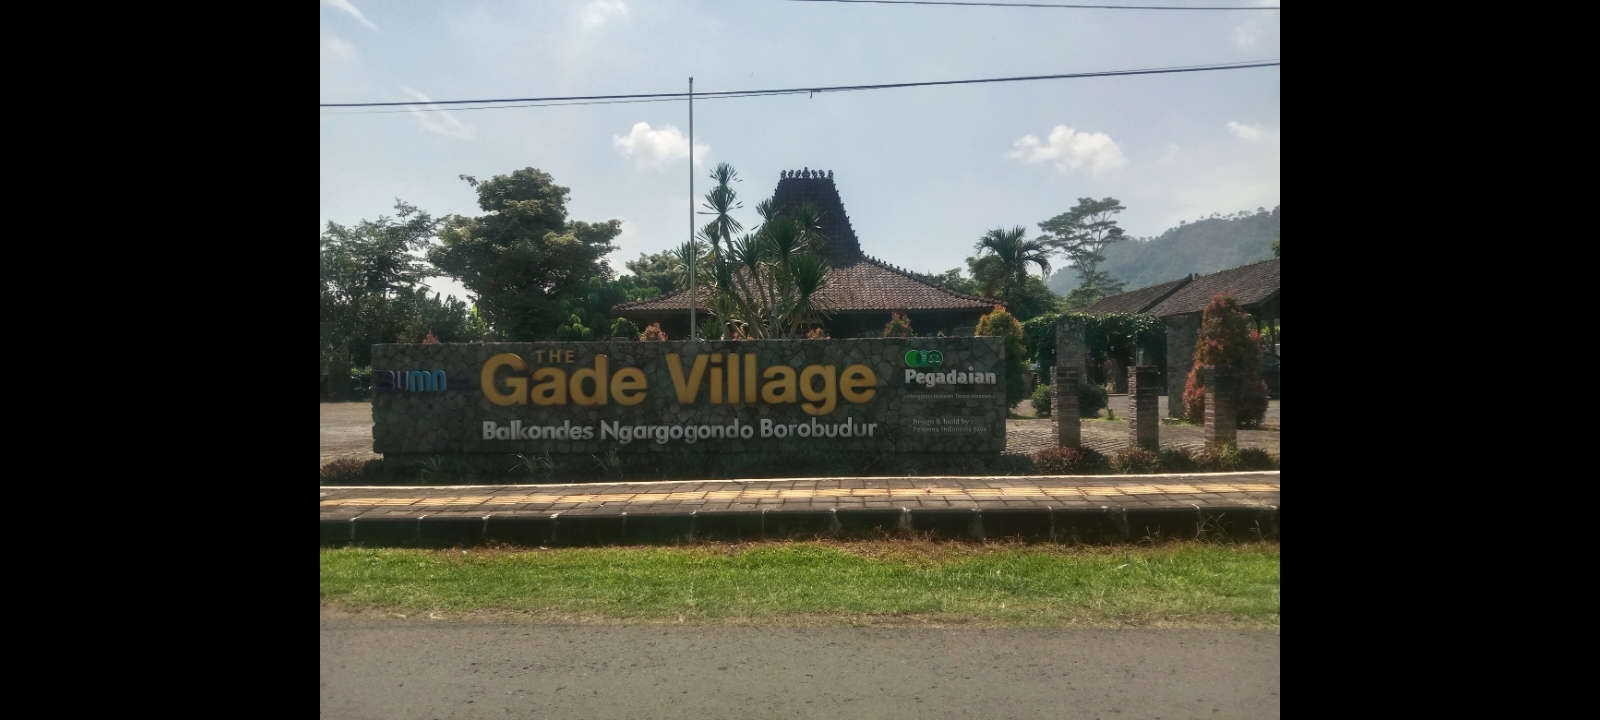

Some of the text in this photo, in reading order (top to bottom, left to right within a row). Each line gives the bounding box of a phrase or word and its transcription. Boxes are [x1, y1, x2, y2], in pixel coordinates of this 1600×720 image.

[535, 350, 576, 364] THE
[480, 352, 878, 416] Gade Village
[904, 365, 997, 388] Pegadaian
[482, 416, 878, 445] Balkondes Ngargogondo Borobudur
